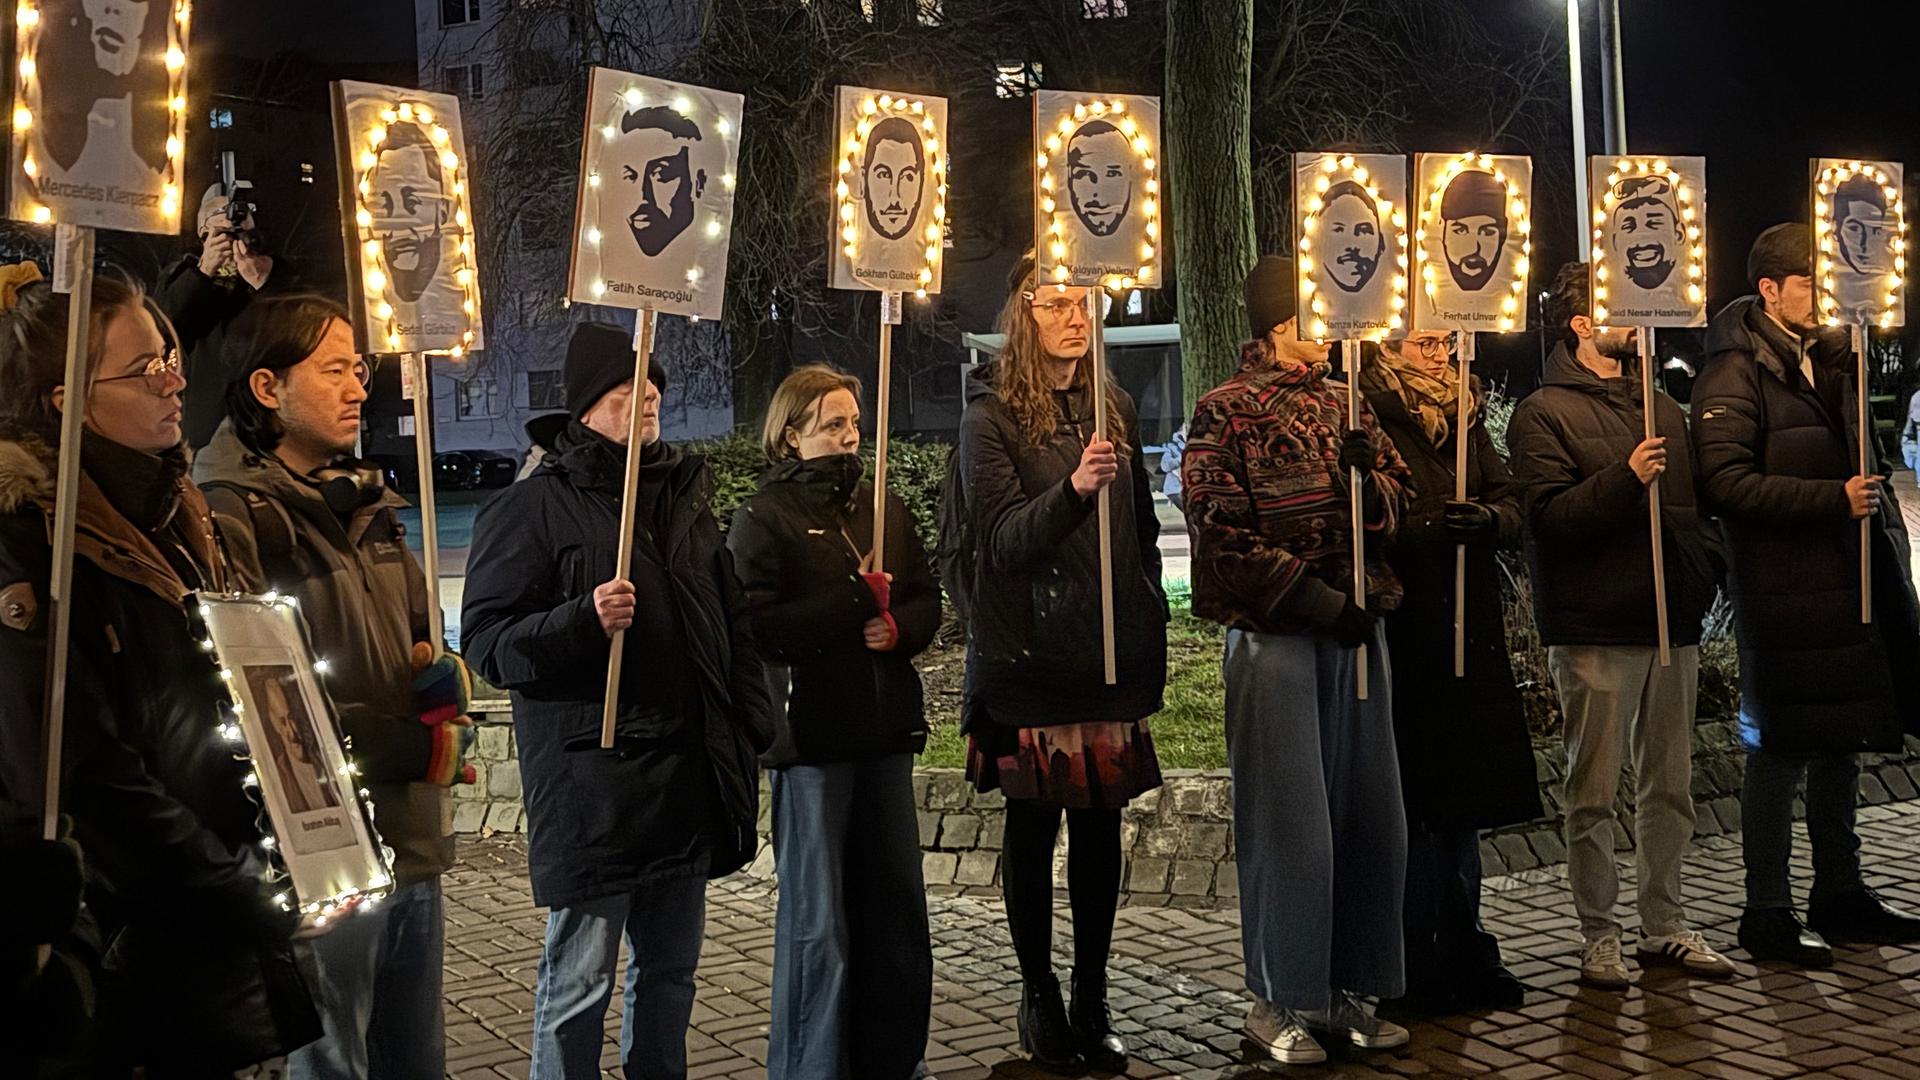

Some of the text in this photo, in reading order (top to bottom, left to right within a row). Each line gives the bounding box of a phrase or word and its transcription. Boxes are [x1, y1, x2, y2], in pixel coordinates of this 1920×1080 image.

[37, 176, 104, 201] Mercedes
[855, 268, 888, 279] Gökhan
[1067, 264, 1102, 275] Kaloyan
[606, 280, 693, 303] Fatih Saraçoğlu
[1443, 312, 1497, 321] Ferhat Unvar
[1627, 308, 1653, 317] Nesar
